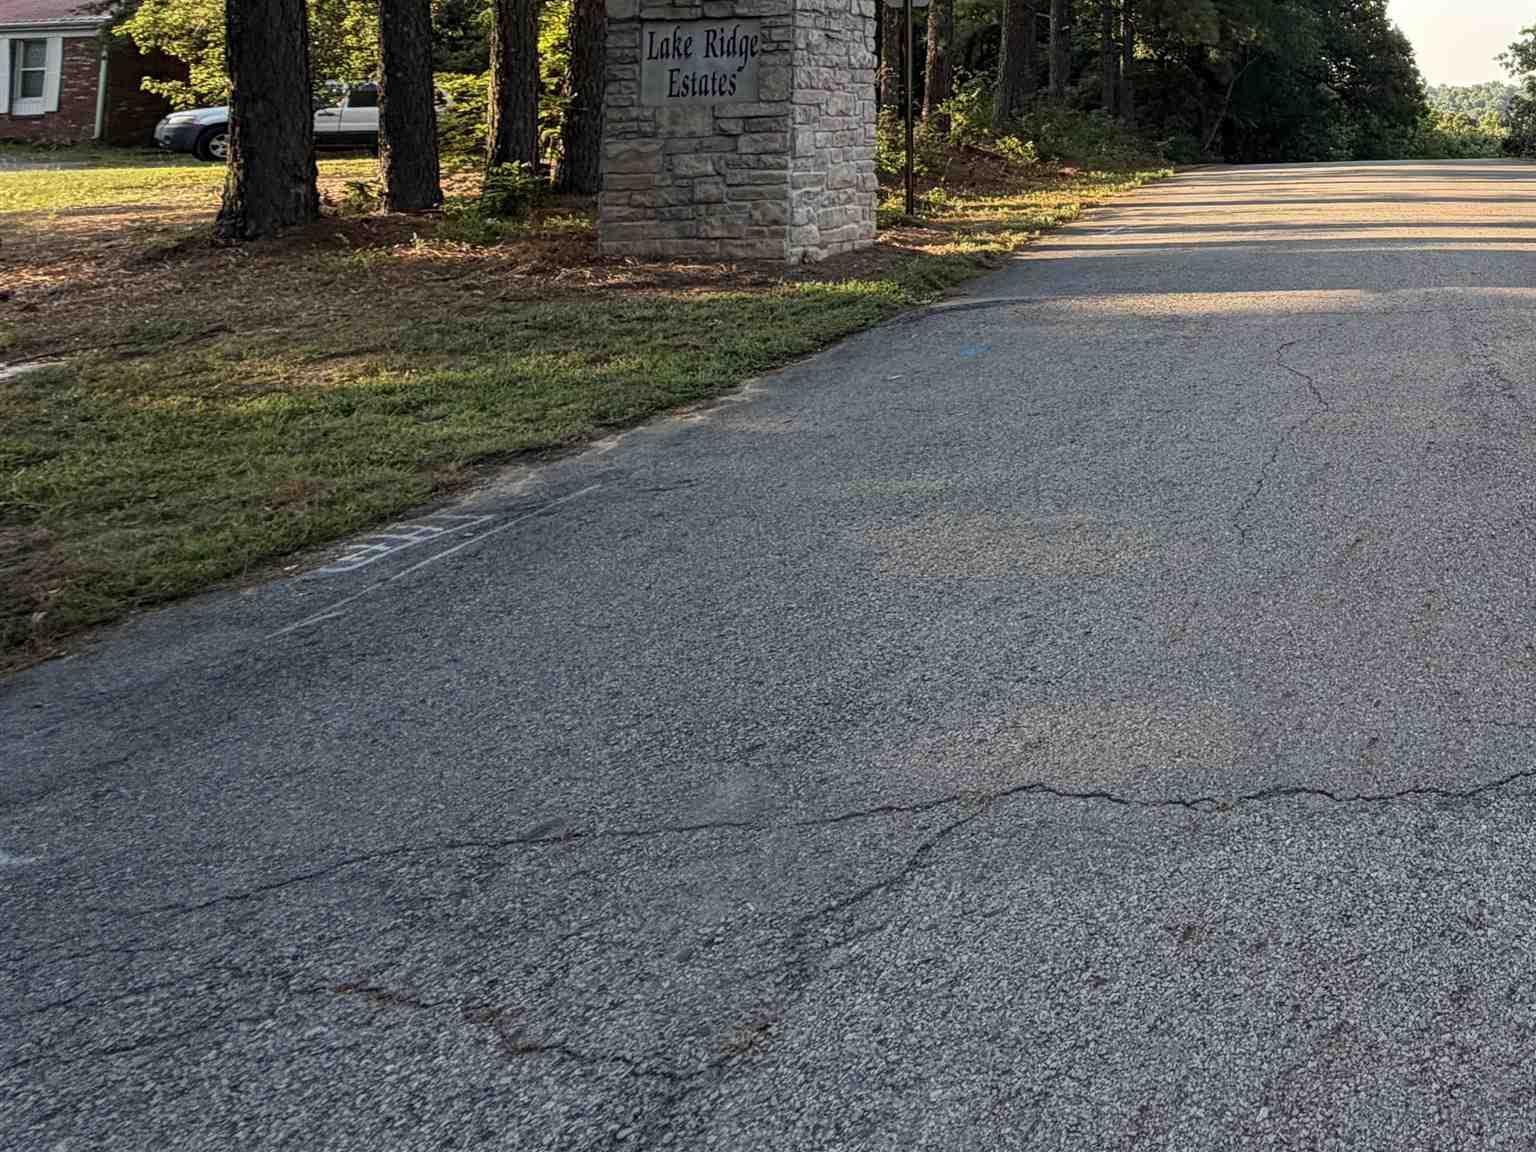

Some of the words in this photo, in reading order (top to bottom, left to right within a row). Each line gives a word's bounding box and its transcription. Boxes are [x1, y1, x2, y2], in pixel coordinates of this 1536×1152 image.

[646, 25, 694, 60] Lake
[703, 23, 759, 73] Ridge
[667, 67, 738, 98] Estates
